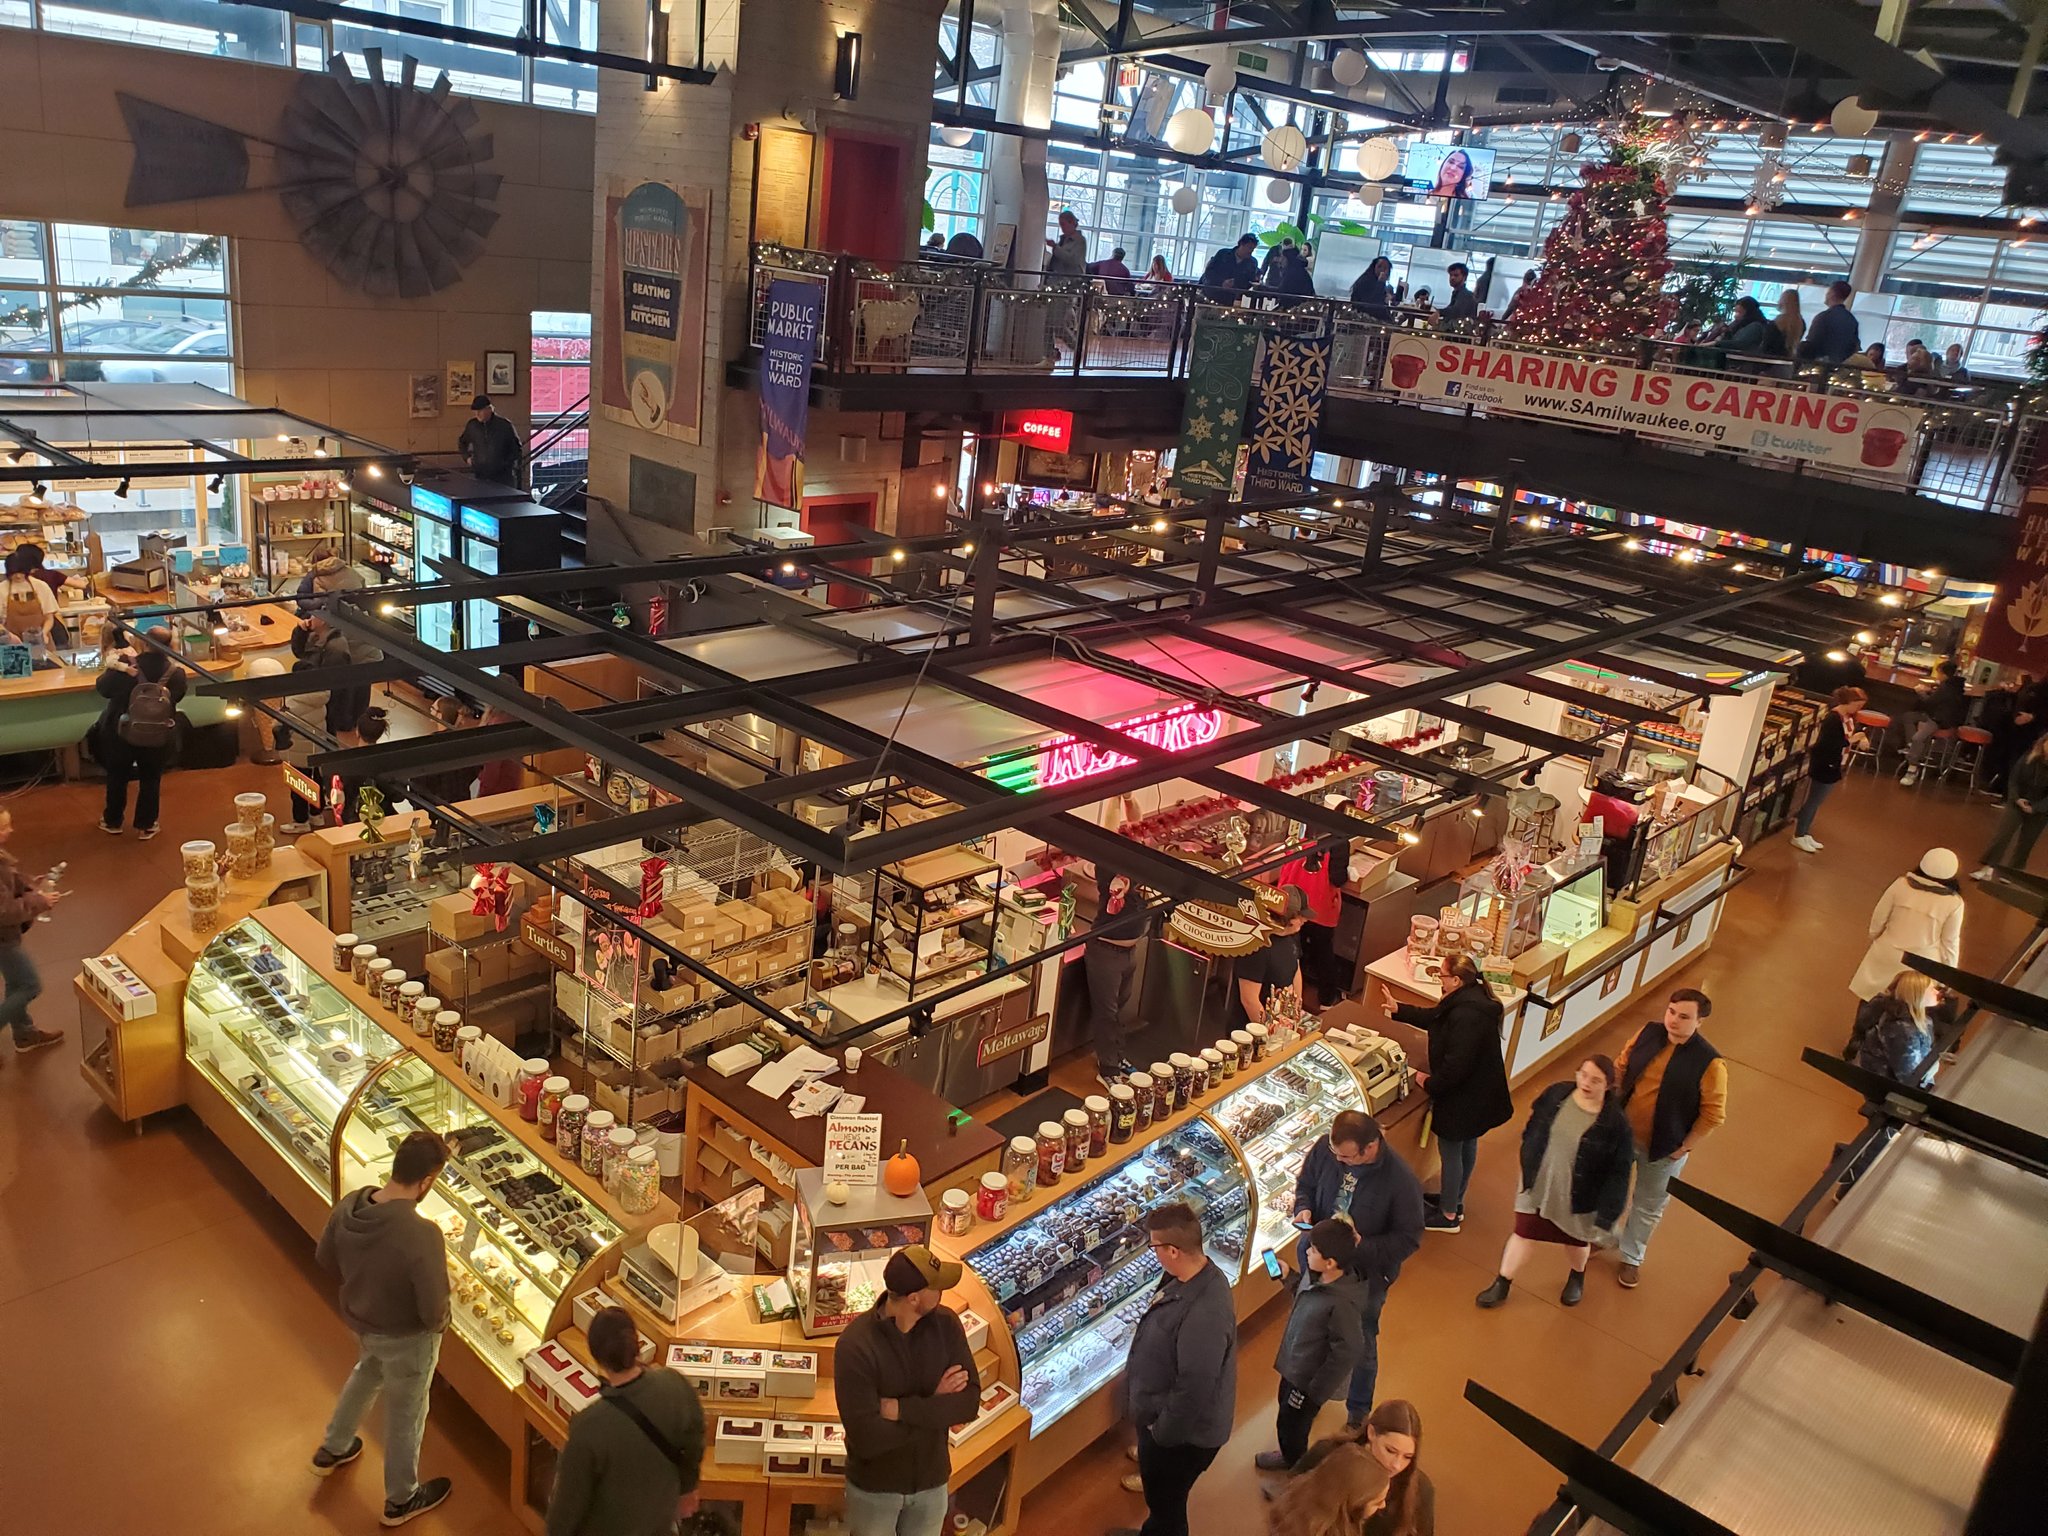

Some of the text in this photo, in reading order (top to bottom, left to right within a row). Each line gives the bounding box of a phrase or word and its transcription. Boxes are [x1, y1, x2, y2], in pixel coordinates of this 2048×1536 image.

[1121, 69, 1137, 85] EXIT
[632, 282, 671, 300] SEATING
[631, 310, 671, 329] KITCHEN
[771, 300, 814, 323] PUBLIC
[767, 318, 814, 341] MARKET
[769, 348, 804, 362] HISTORIC
[768, 358, 803, 375] THIRD
[768, 371, 802, 389] WARD
[1465, 382, 1478, 391] Find
[1435, 344, 1860, 435] SHARING IS CARING
[1463, 390, 1504, 405] Facebook
[1524, 393, 1727, 441] www.SAmilwaukee.org
[1023, 421, 1062, 439] COFFEE
[1771, 433, 1832, 456] twitter
[1181, 475, 1224, 488] THIRD WARD
[1256, 466, 1300, 481] HISTORIC
[1250, 475, 1304, 494] THIRD WARD
[284, 769, 317, 802] Truffles
[1255, 885, 1285, 905] Cashier
[1183, 922, 1235, 943] CHOCOLATES
[526, 925, 568, 961] Turtles
[982, 1022, 1047, 1058] Meltaways
[828, 1122, 877, 1134] Almonds
[829, 1140, 877, 1151] PECANS
[830, 1313, 859, 1321] WARNIN
